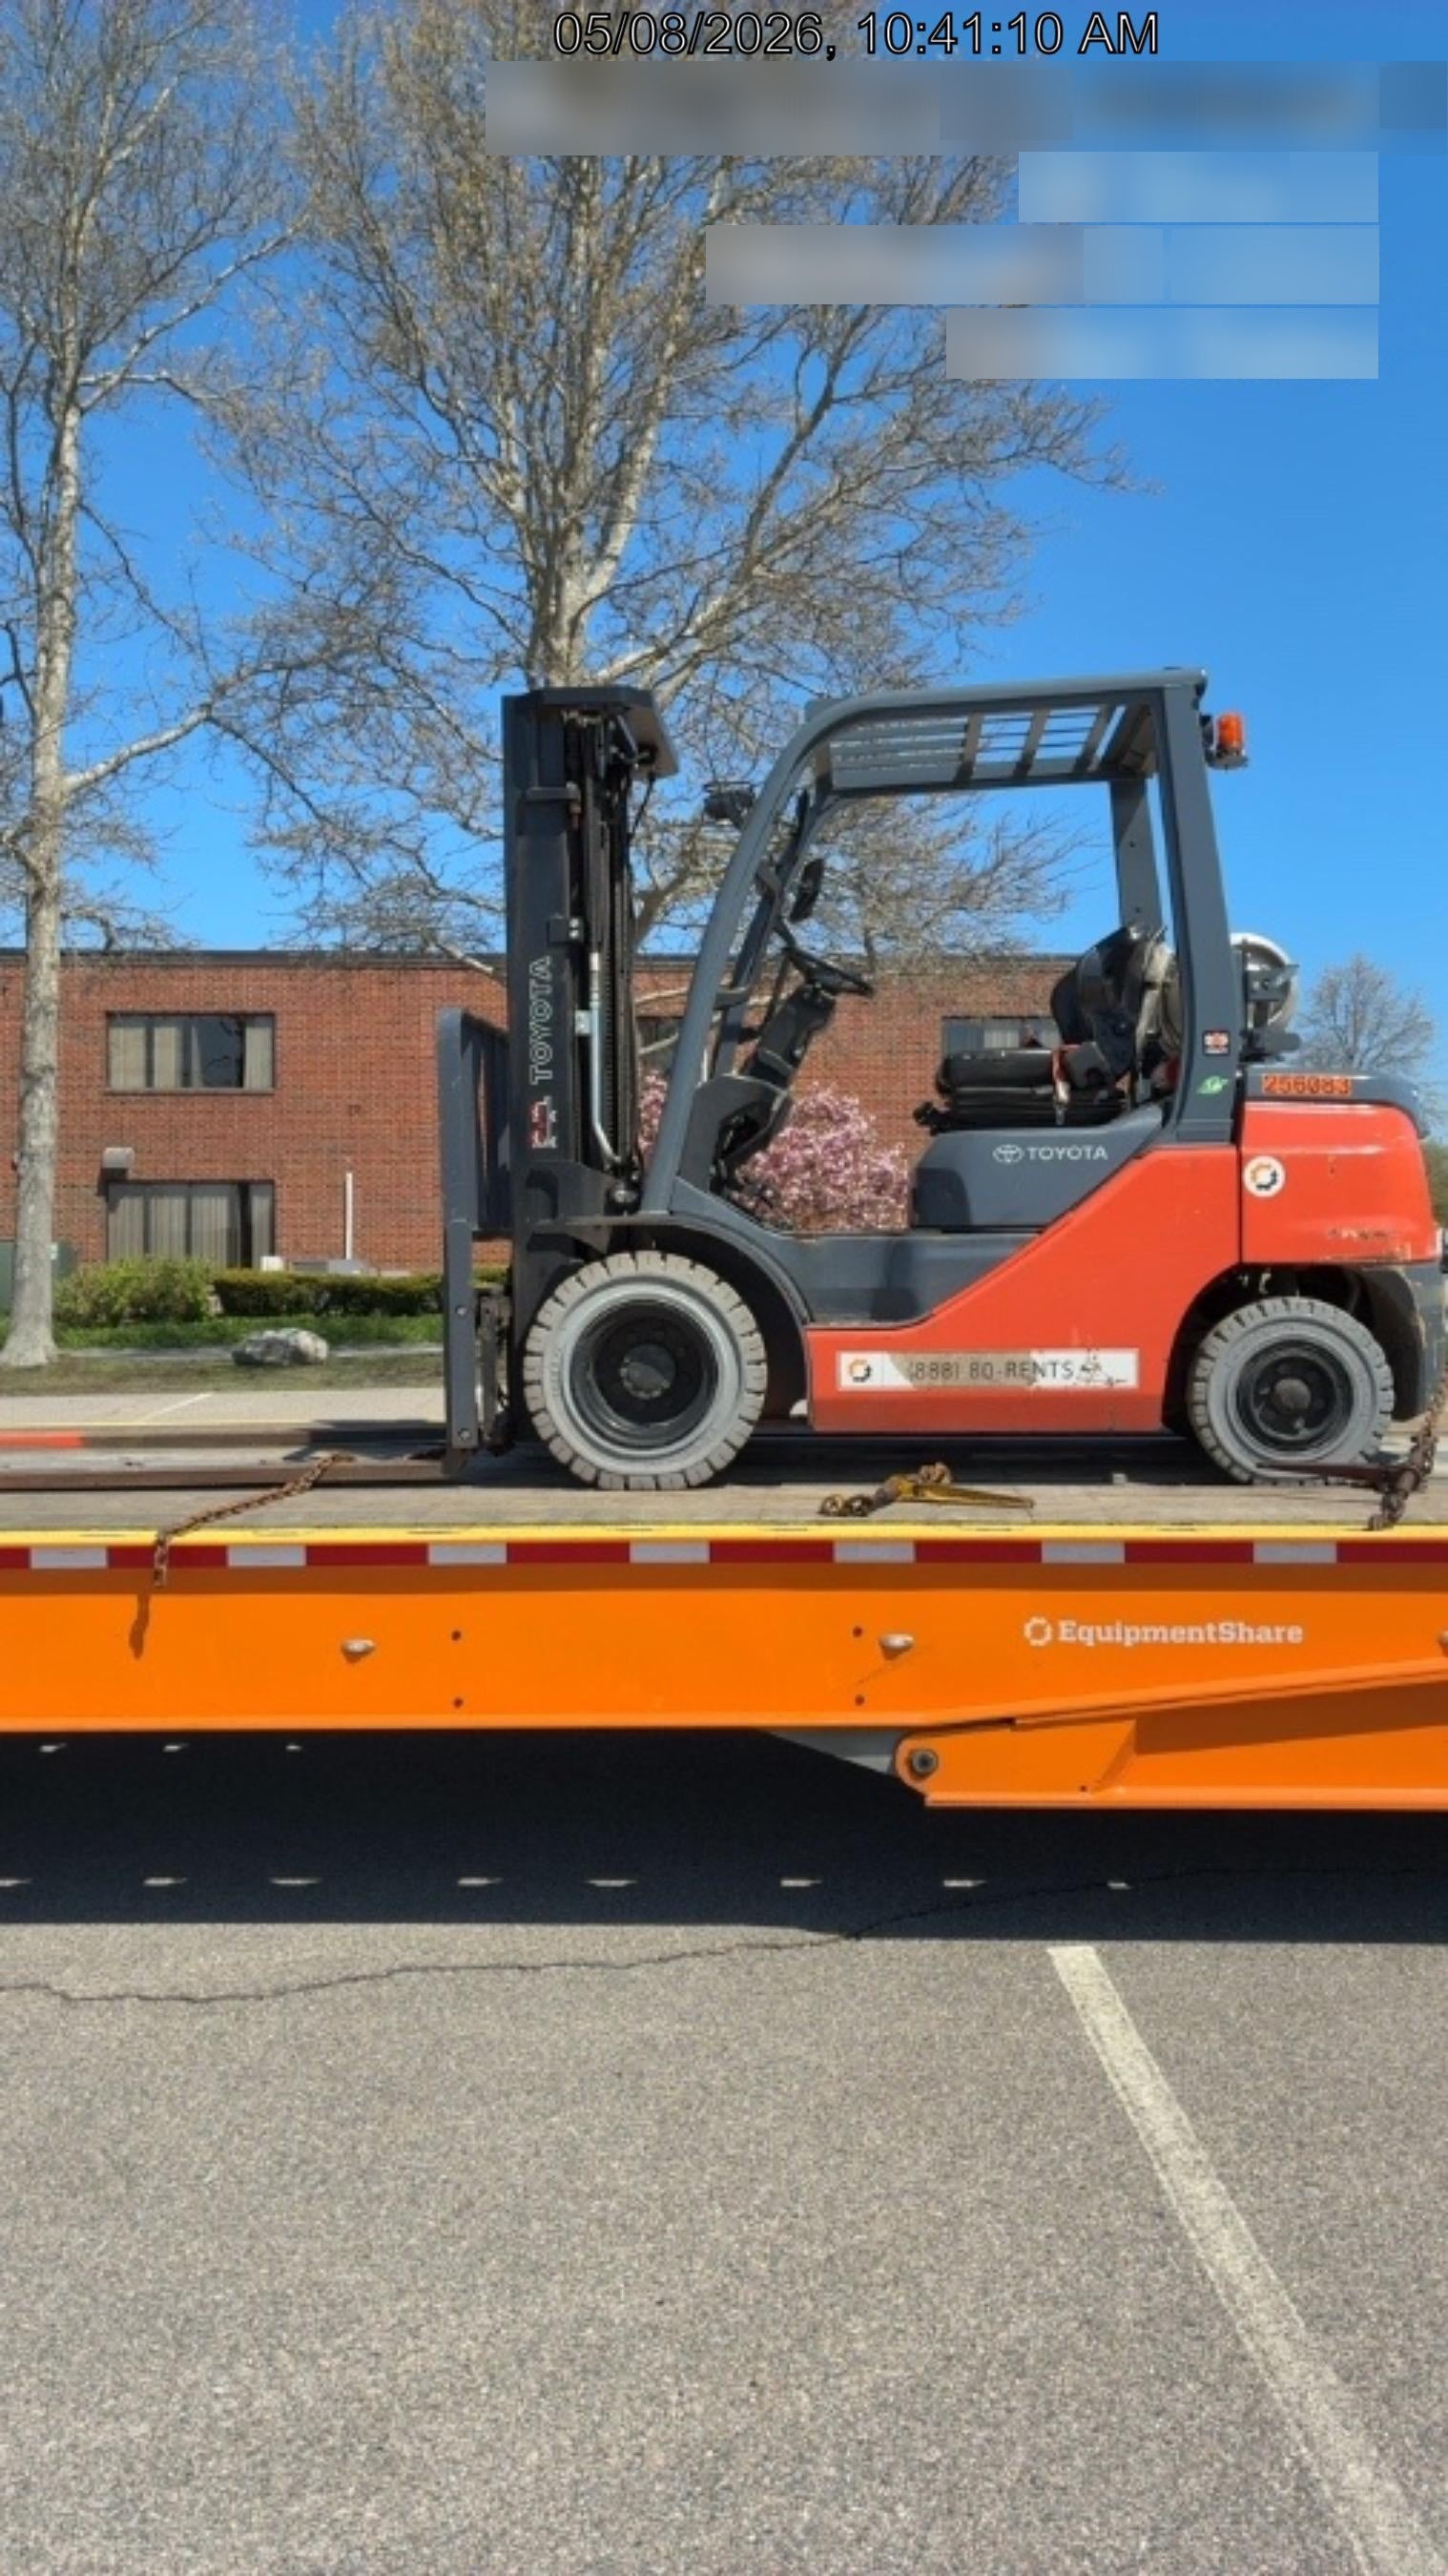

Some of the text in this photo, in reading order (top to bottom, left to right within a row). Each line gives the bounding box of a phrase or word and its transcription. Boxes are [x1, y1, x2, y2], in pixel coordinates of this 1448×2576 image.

[529, 955, 553, 1086] TOYOTA
[1264, 1074, 1350, 1095] 256083
[1026, 1146, 1108, 1160] TOYOTA
[969, 1361, 1074, 1380] 80-RENTS
[1058, 1620, 1304, 1646] EquipmentShare
